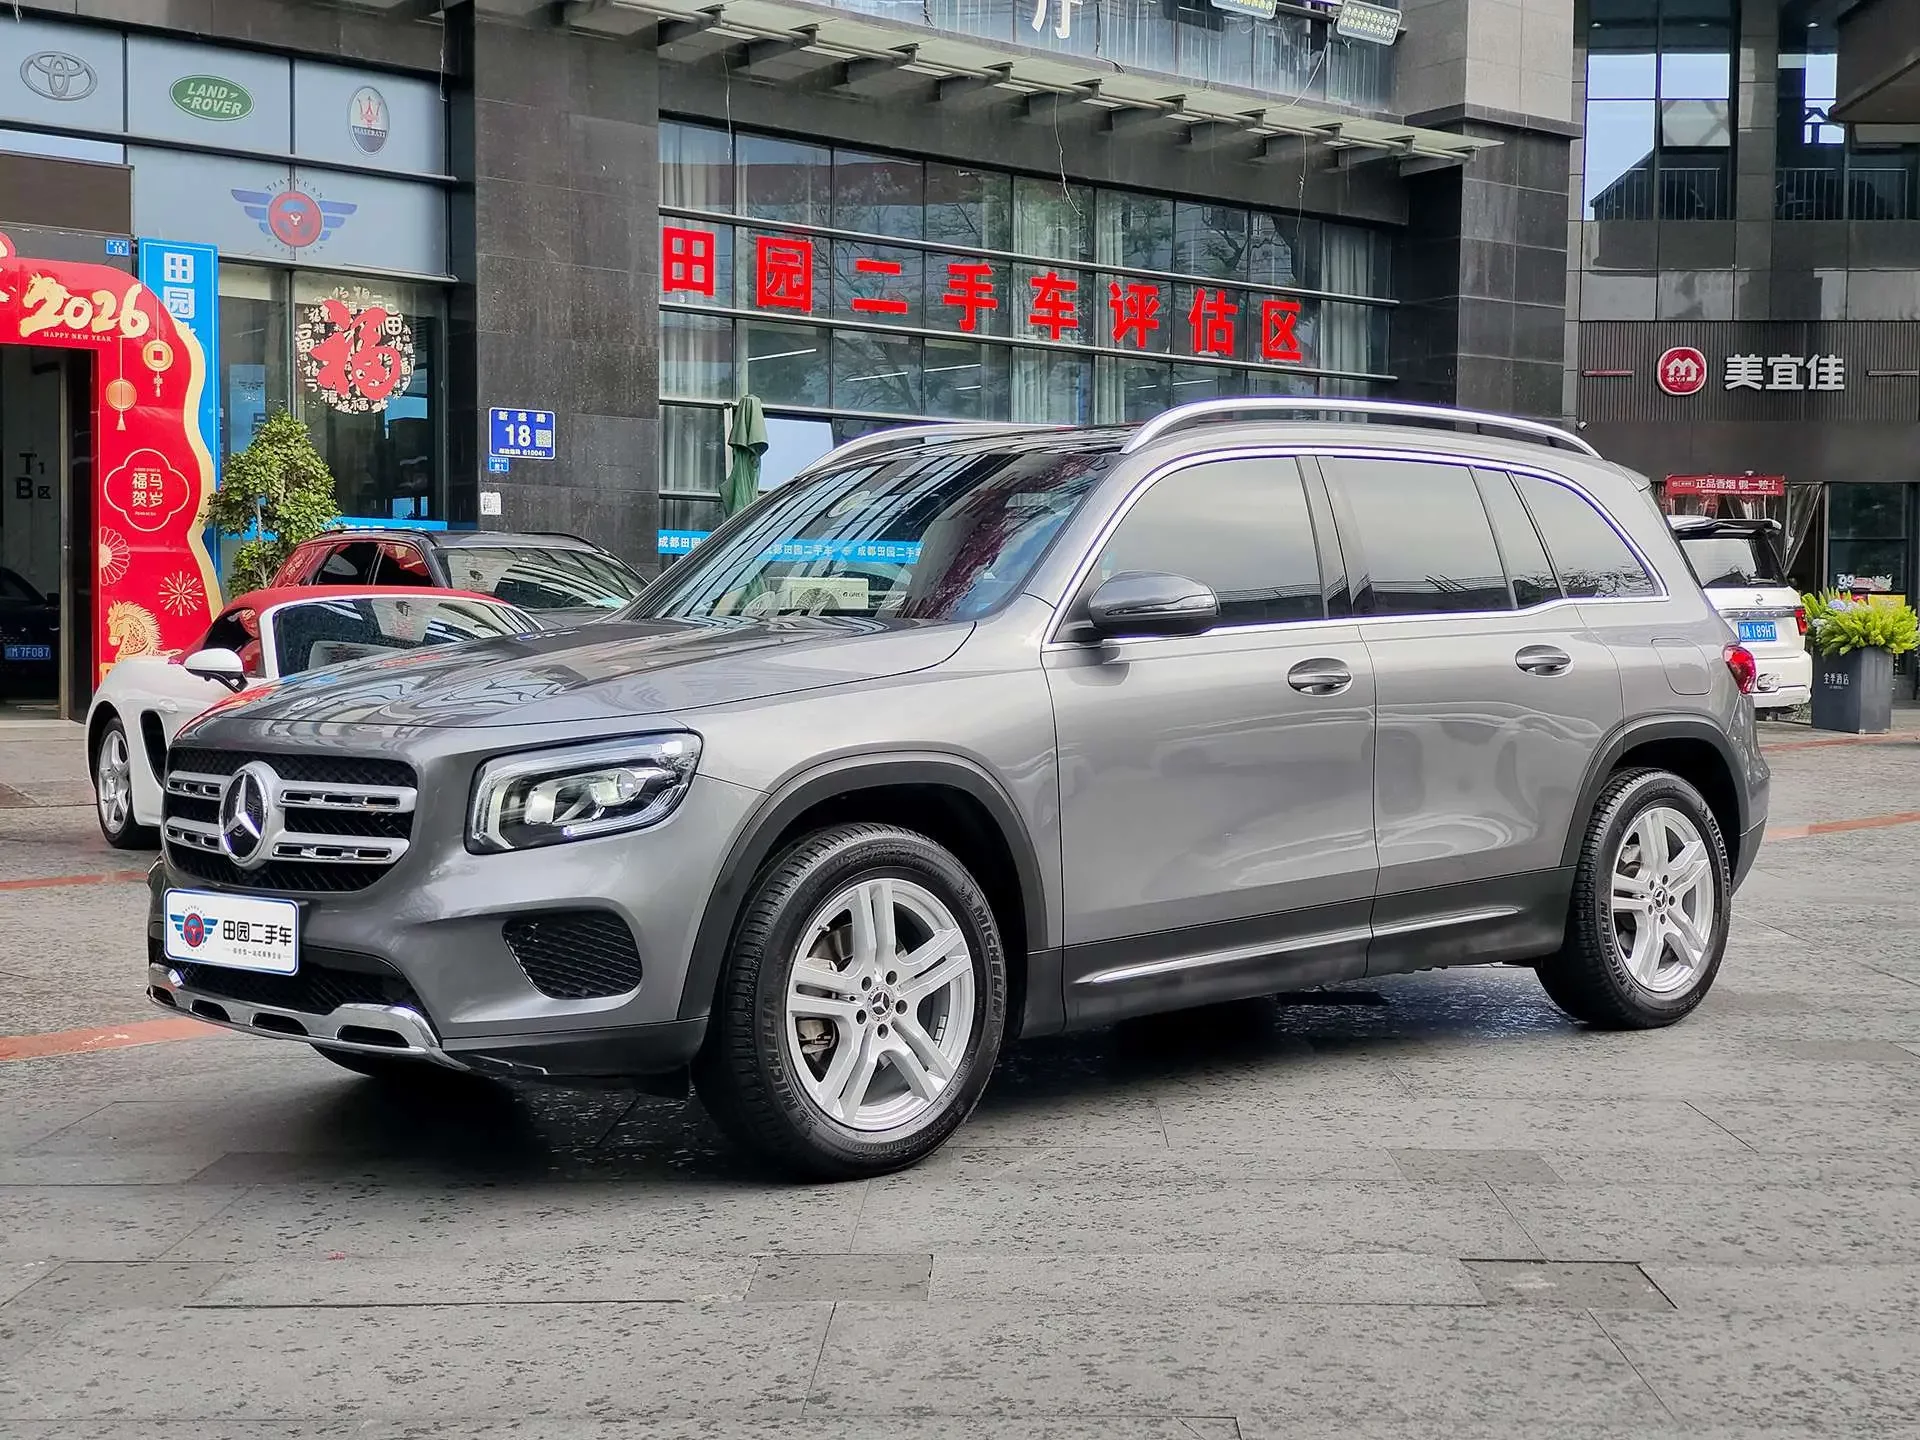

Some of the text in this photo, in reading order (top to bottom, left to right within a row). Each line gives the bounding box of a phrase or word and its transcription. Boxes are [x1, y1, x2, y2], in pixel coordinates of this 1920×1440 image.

[187, 82, 227, 100] LAND
[190, 96, 242, 116] ROVER
[353, 126, 387, 138] MASERATI
[20, 271, 150, 339] 2026
[163, 252, 197, 334] 田园
[663, 227, 1302, 361] 田园二手车评估区
[43, 331, 112, 343] HAPPY NEW YEAR
[1723, 353, 1846, 391] 美宜佳
[505, 423, 531, 447] 18
[132, 472, 163, 490] 福马
[1695, 478, 1736, 490] 正品香烟
[132, 490, 163, 508] 贺岁
[1709, 818, 1731, 894] MICHELIN
[223, 920, 292, 946] 田园二手车
[1600, 901, 1628, 987] MICHELIN
[972, 904, 1006, 1022] MICHELIN
